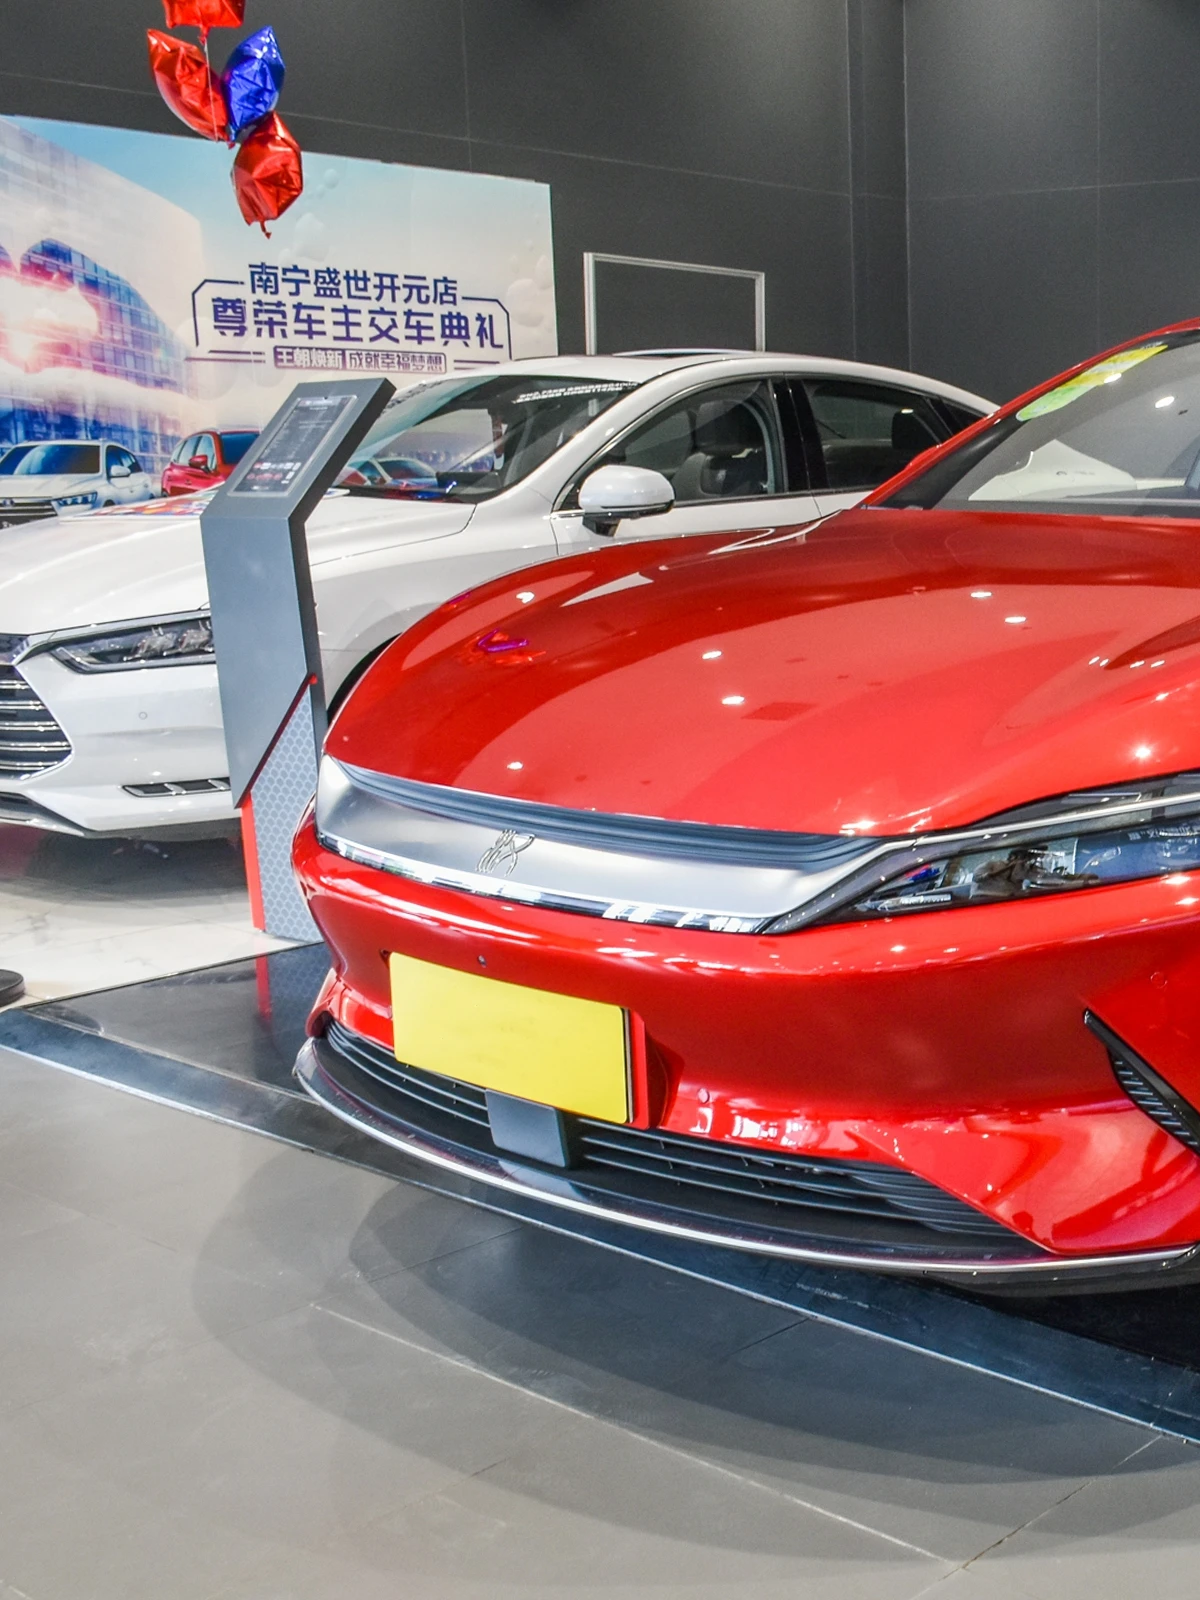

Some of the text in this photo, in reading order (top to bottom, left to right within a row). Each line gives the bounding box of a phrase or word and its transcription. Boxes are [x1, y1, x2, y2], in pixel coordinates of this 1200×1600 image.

[248, 262, 458, 306] 南宁盛世开元店
[211, 297, 504, 348] 尊荣车主交车典礼
[349, 351, 442, 372] 成就幸福梦想
